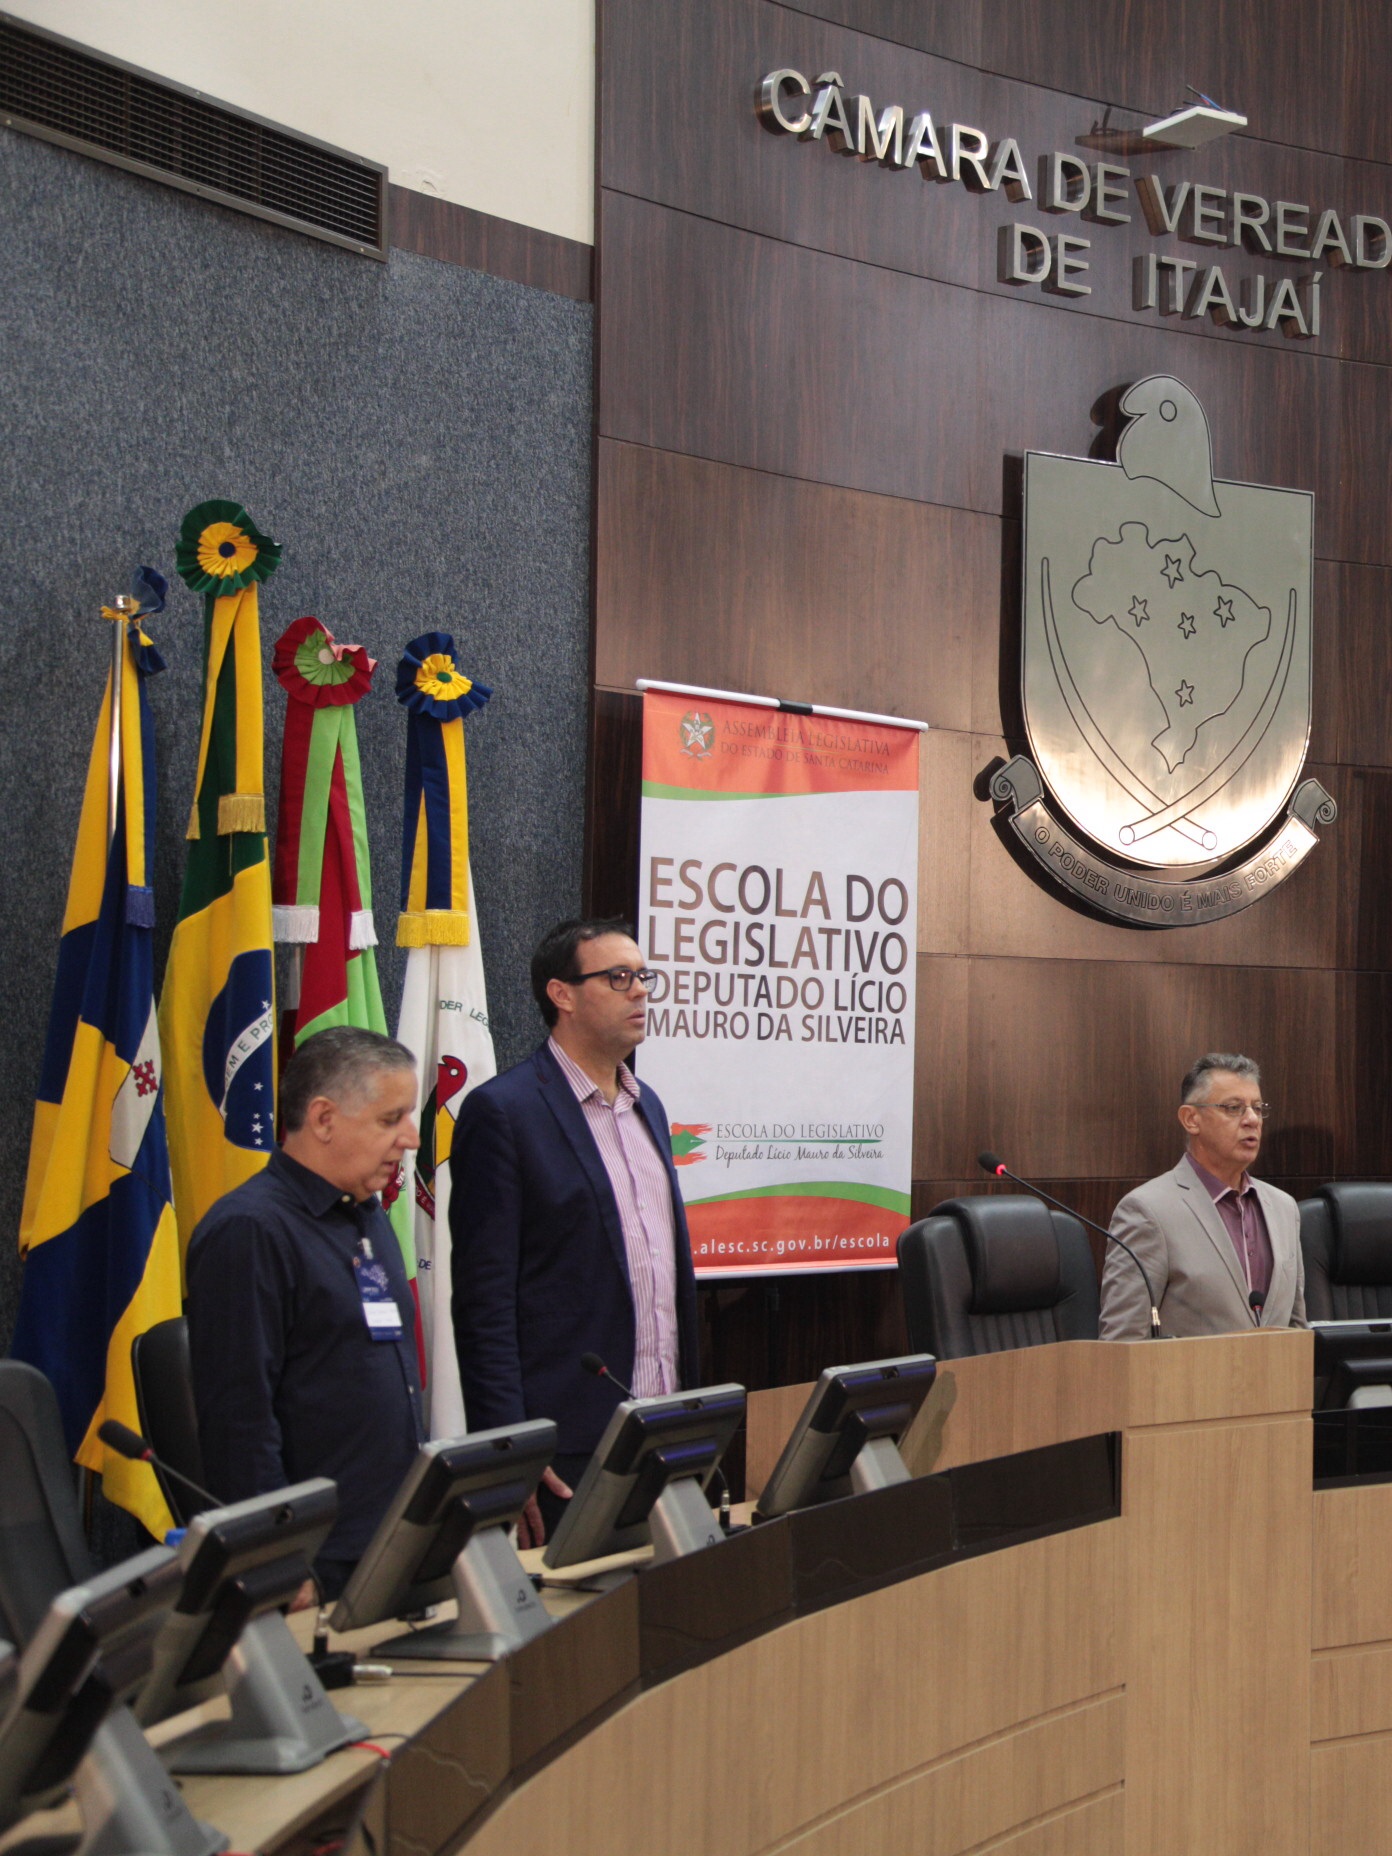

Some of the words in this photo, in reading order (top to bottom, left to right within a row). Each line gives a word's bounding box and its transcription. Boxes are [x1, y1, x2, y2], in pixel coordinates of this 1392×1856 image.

[756, 68, 1033, 202] CÂMARA
[1042, 150, 1133, 226] DE
[1003, 221, 1093, 298] DE
[1138, 251, 1322, 338] ITAJAÍ
[720, 740, 739, 754] DO
[741, 743, 783, 761] ESTADO
[785, 750, 802, 763] DE
[803, 751, 836, 768] SANTA
[838, 757, 889, 775] CATARINA
[722, 719, 805, 744] ASSEMBLEIA
[807, 731, 891, 757] LEGISLATIVA
[1034, 826, 1051, 846] O
[1048, 841, 1110, 895] PODER
[1113, 883, 1176, 912] UNIDO
[1179, 891, 1193, 912] É
[1195, 882, 1244, 911] MAIS
[1245, 839, 1300, 893] FORTE
[649, 856, 832, 921] ESCOLA
[846, 874, 909, 926] DO
[648, 915, 909, 975] LEGISLATIVO
[646, 968, 825, 1011] DEPUTADO
[833, 972, 908, 1014] LÍCIO
[237, 1040, 251, 1053] E
[646, 1008, 750, 1041] MAURO
[757, 1012, 794, 1042] DA
[801, 1014, 907, 1046] SILVEIRA
[716, 1123, 768, 1139] ESCOLA
[773, 1123, 796, 1139] DO
[800, 1123, 885, 1139] LEGISLATIVO
[715, 1144, 764, 1169] Deputado
[766, 1144, 792, 1161] Lício
[794, 1145, 829, 1161] Mauro
[832, 1144, 845, 1160] da
[847, 1143, 884, 1160] Silveira
